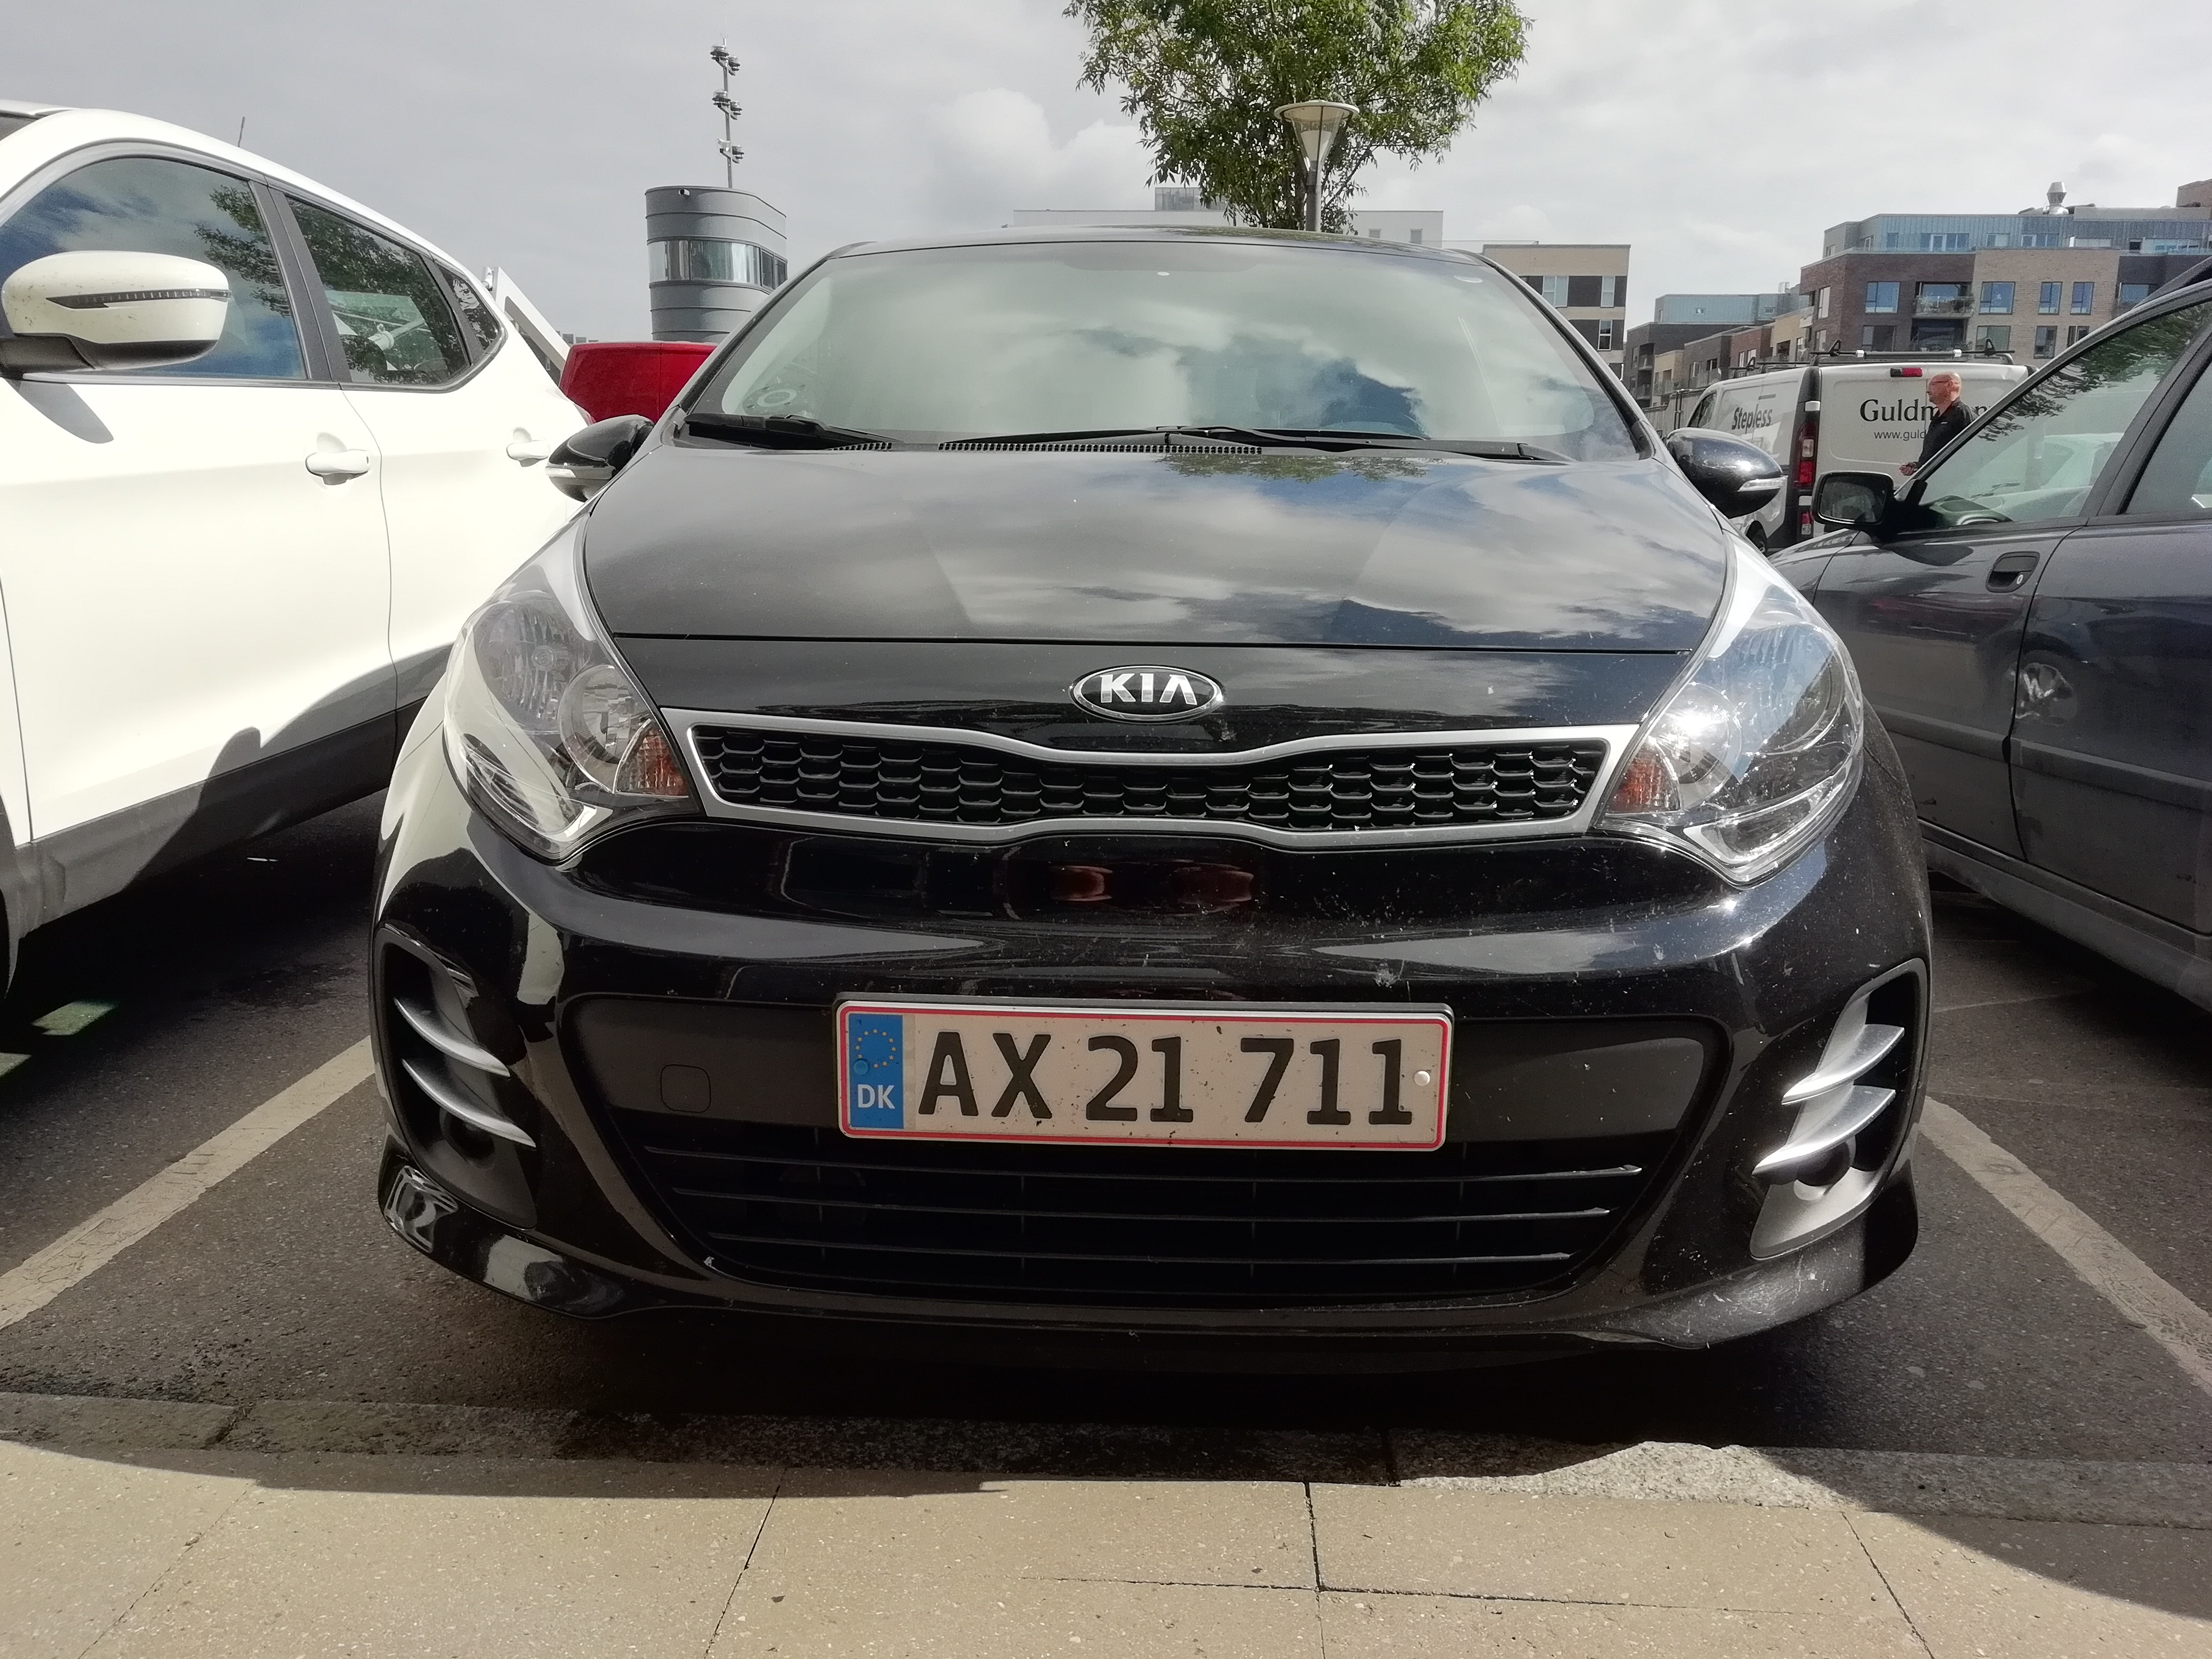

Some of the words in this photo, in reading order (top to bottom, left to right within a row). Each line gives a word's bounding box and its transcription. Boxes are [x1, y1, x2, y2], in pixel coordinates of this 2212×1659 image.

[1732, 404, 1773, 434] Stepless
[1100, 673, 1197, 706] KIA
[918, 1032, 1053, 1119] AX
[1085, 1035, 1194, 1123] 21
[1240, 1037, 1413, 1126] 711
[857, 1084, 895, 1109] DK
